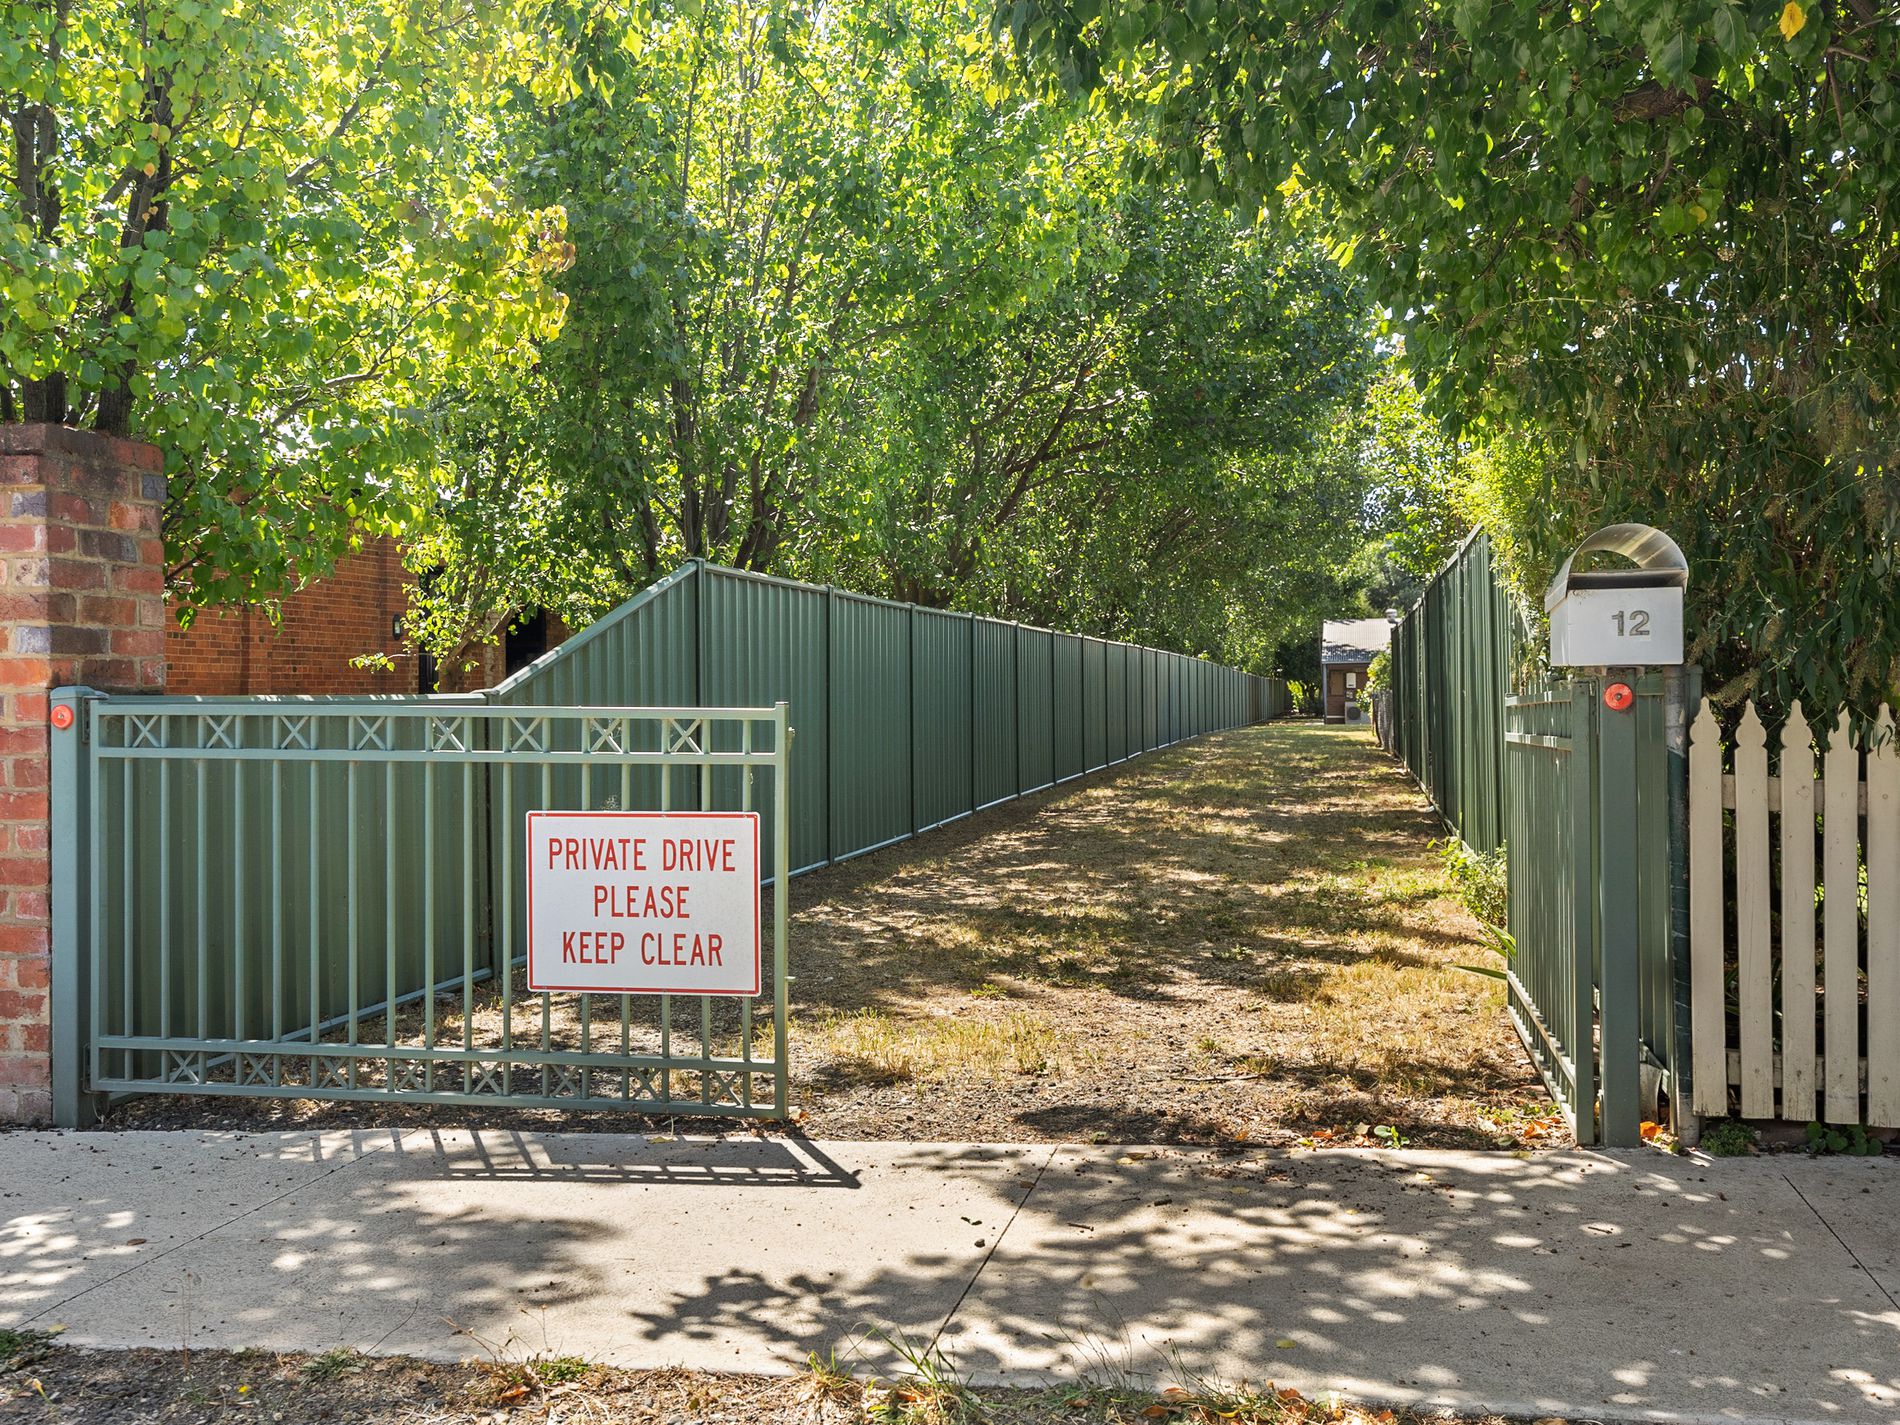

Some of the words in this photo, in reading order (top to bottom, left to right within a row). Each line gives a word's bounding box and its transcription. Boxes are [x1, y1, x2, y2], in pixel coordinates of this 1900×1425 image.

[1611, 610, 1650, 637] 12
[549, 838, 647, 871] PRIVATE
[662, 839, 736, 872] DRIVE
[594, 885, 690, 918] PLEASE
[562, 931, 625, 964] KEEP
[641, 932, 723, 966] CLEAR
